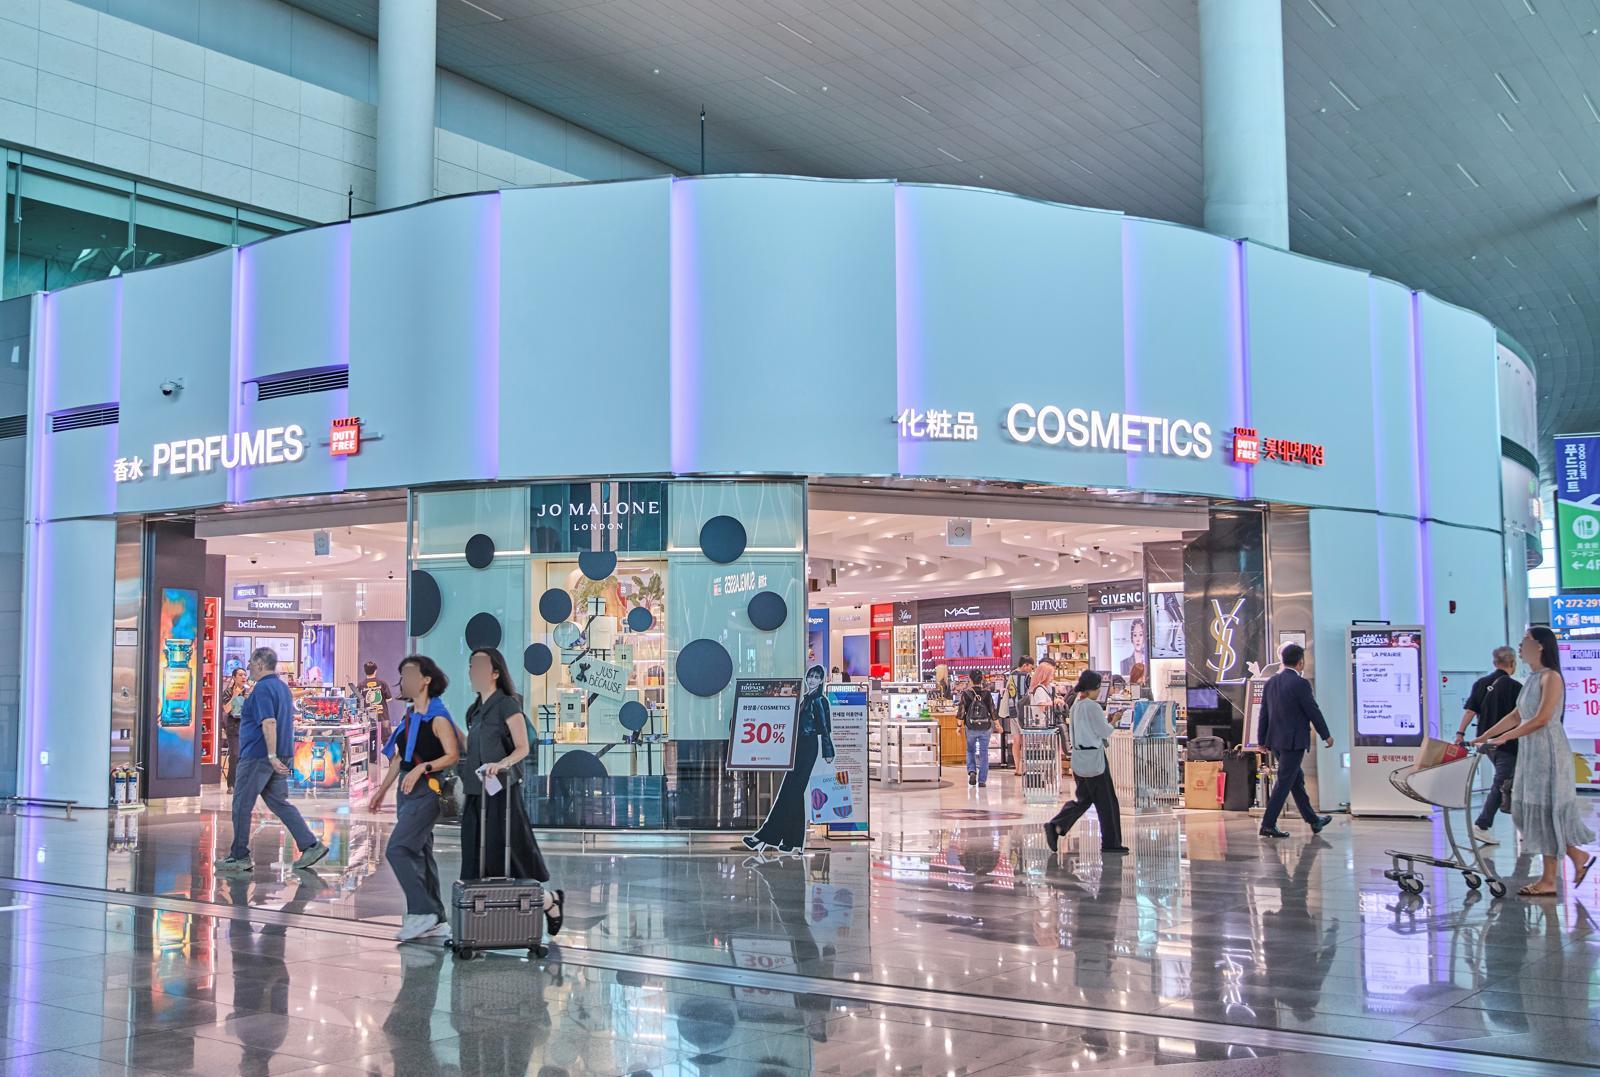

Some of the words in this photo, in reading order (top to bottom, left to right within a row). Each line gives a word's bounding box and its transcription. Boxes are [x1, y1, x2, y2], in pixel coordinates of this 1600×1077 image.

[898, 408, 978, 440] 化粧品
[1006, 402, 1213, 459] COSMETICS
[332, 430, 356, 441] DUTY
[152, 424, 304, 477] PERFUMES
[332, 440, 355, 452] FREE
[1238, 439, 1258, 450] DUTY
[1238, 450, 1258, 460] FREE
[1263, 437, 1325, 467] 롯데면세점
[113, 456, 144, 482] 香水
[1564, 444, 1580, 492] 푸드코트
[1579, 460, 1587, 480] COURT
[537, 504, 562, 517] JO
[569, 501, 660, 516] MALONE
[574, 523, 623, 531] LONDON
[1031, 598, 1068, 611] DIPTYQUE
[1100, 592, 1144, 605] GIVENC
[944, 606, 980, 617] MAC
[238, 620, 257, 629] belif
[596, 666, 619, 680] JUST
[589, 675, 622, 693] BECAUSE
[741, 722, 772, 744] 30
[773, 732, 785, 744] %
